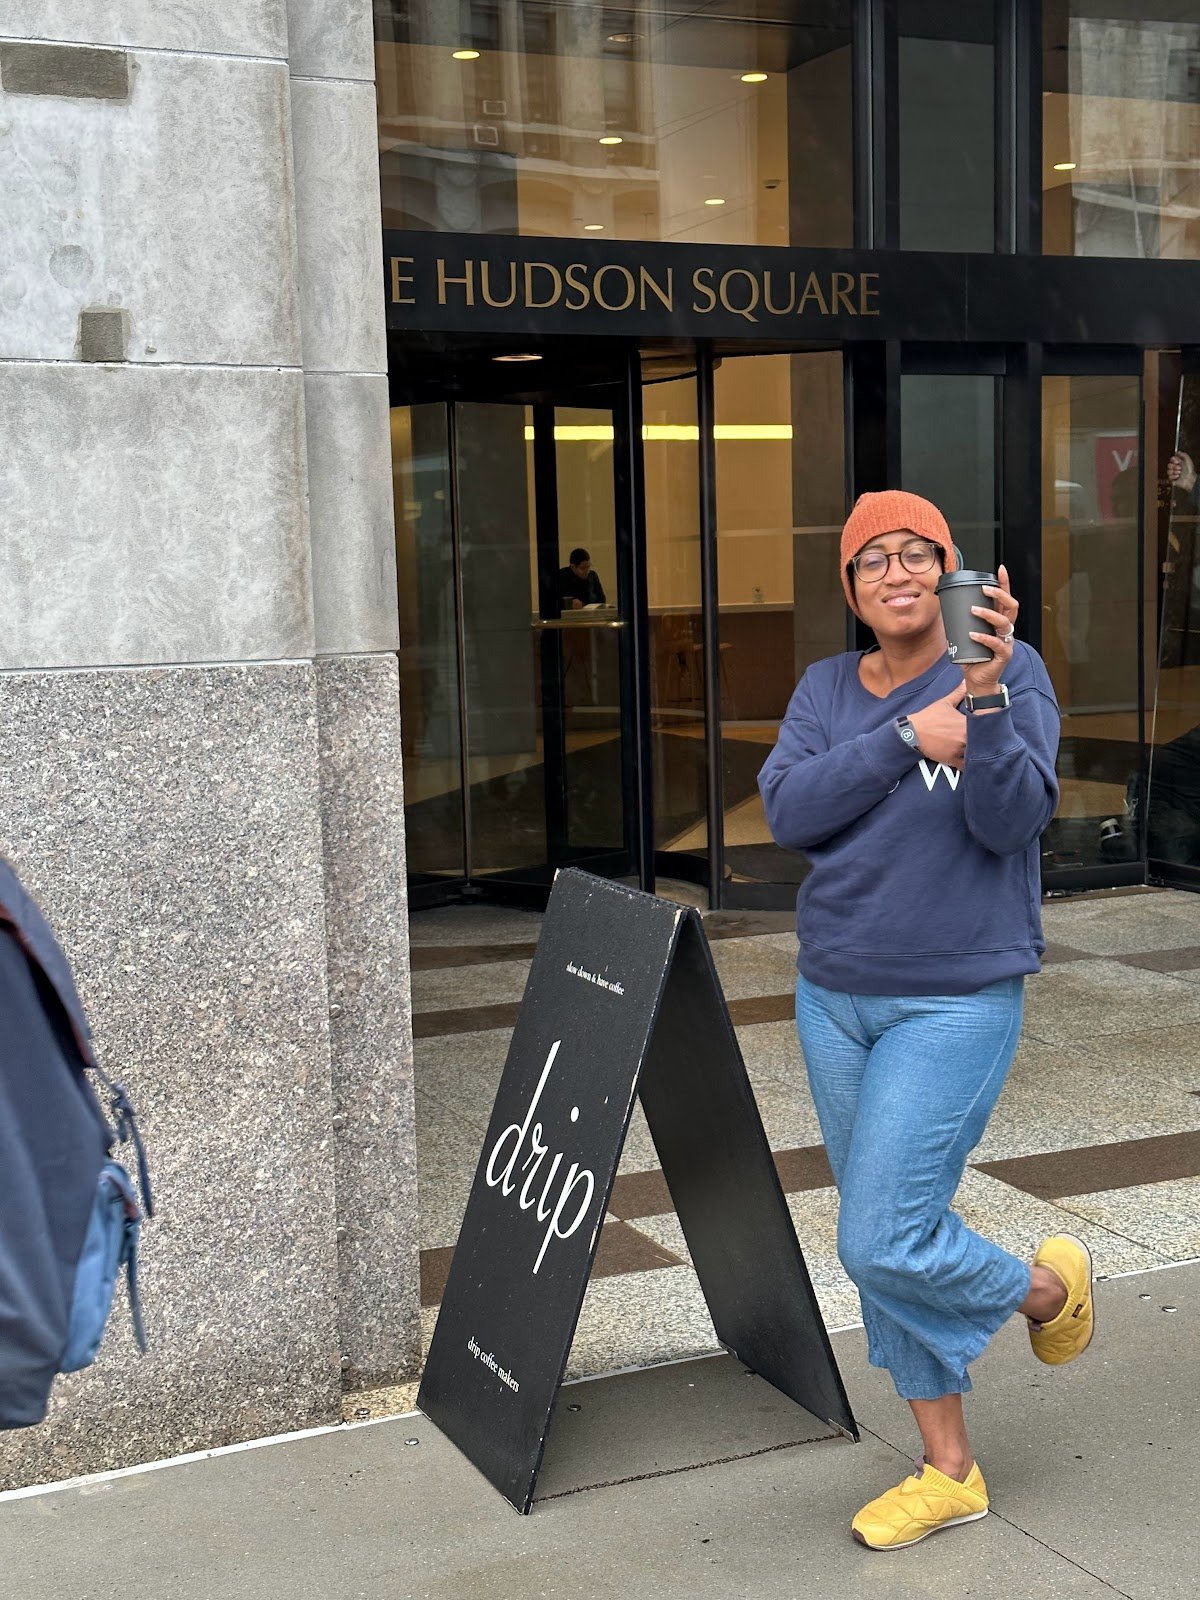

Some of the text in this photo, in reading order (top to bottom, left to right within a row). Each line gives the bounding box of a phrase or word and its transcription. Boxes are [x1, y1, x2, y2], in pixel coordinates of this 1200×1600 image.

[390, 257, 880, 323] E HUDSON SQUARE
[947, 642, 958, 658] ip
[577, 966, 591, 981] down
[591, 974, 597, 983] &
[596, 974, 609, 988] have
[608, 982, 625, 995] coffee
[486, 1040, 595, 1275] drip
[467, 1336, 520, 1393] drip coffee makers
